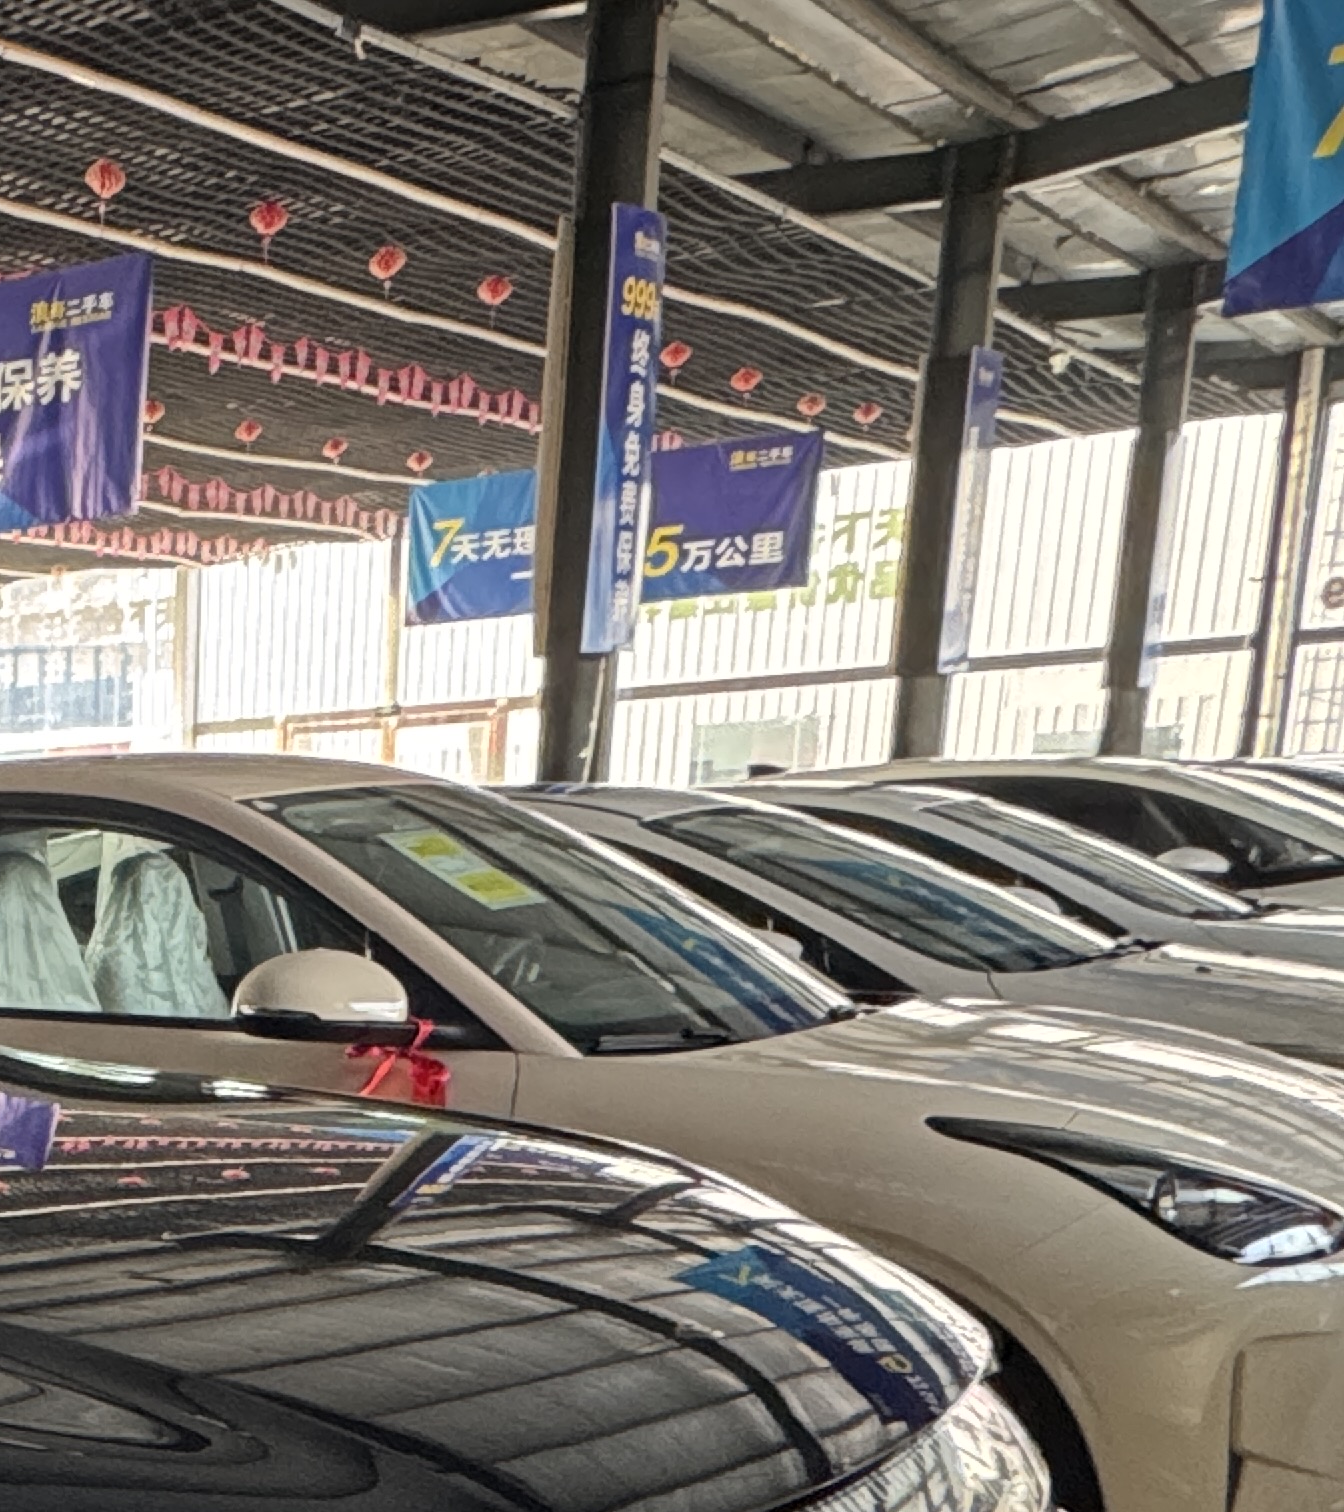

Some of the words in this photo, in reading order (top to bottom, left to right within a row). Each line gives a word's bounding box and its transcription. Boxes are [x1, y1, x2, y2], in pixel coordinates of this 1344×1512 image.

[429, 517, 536, 568] 7天无理
[643, 523, 785, 578] 5万公里
